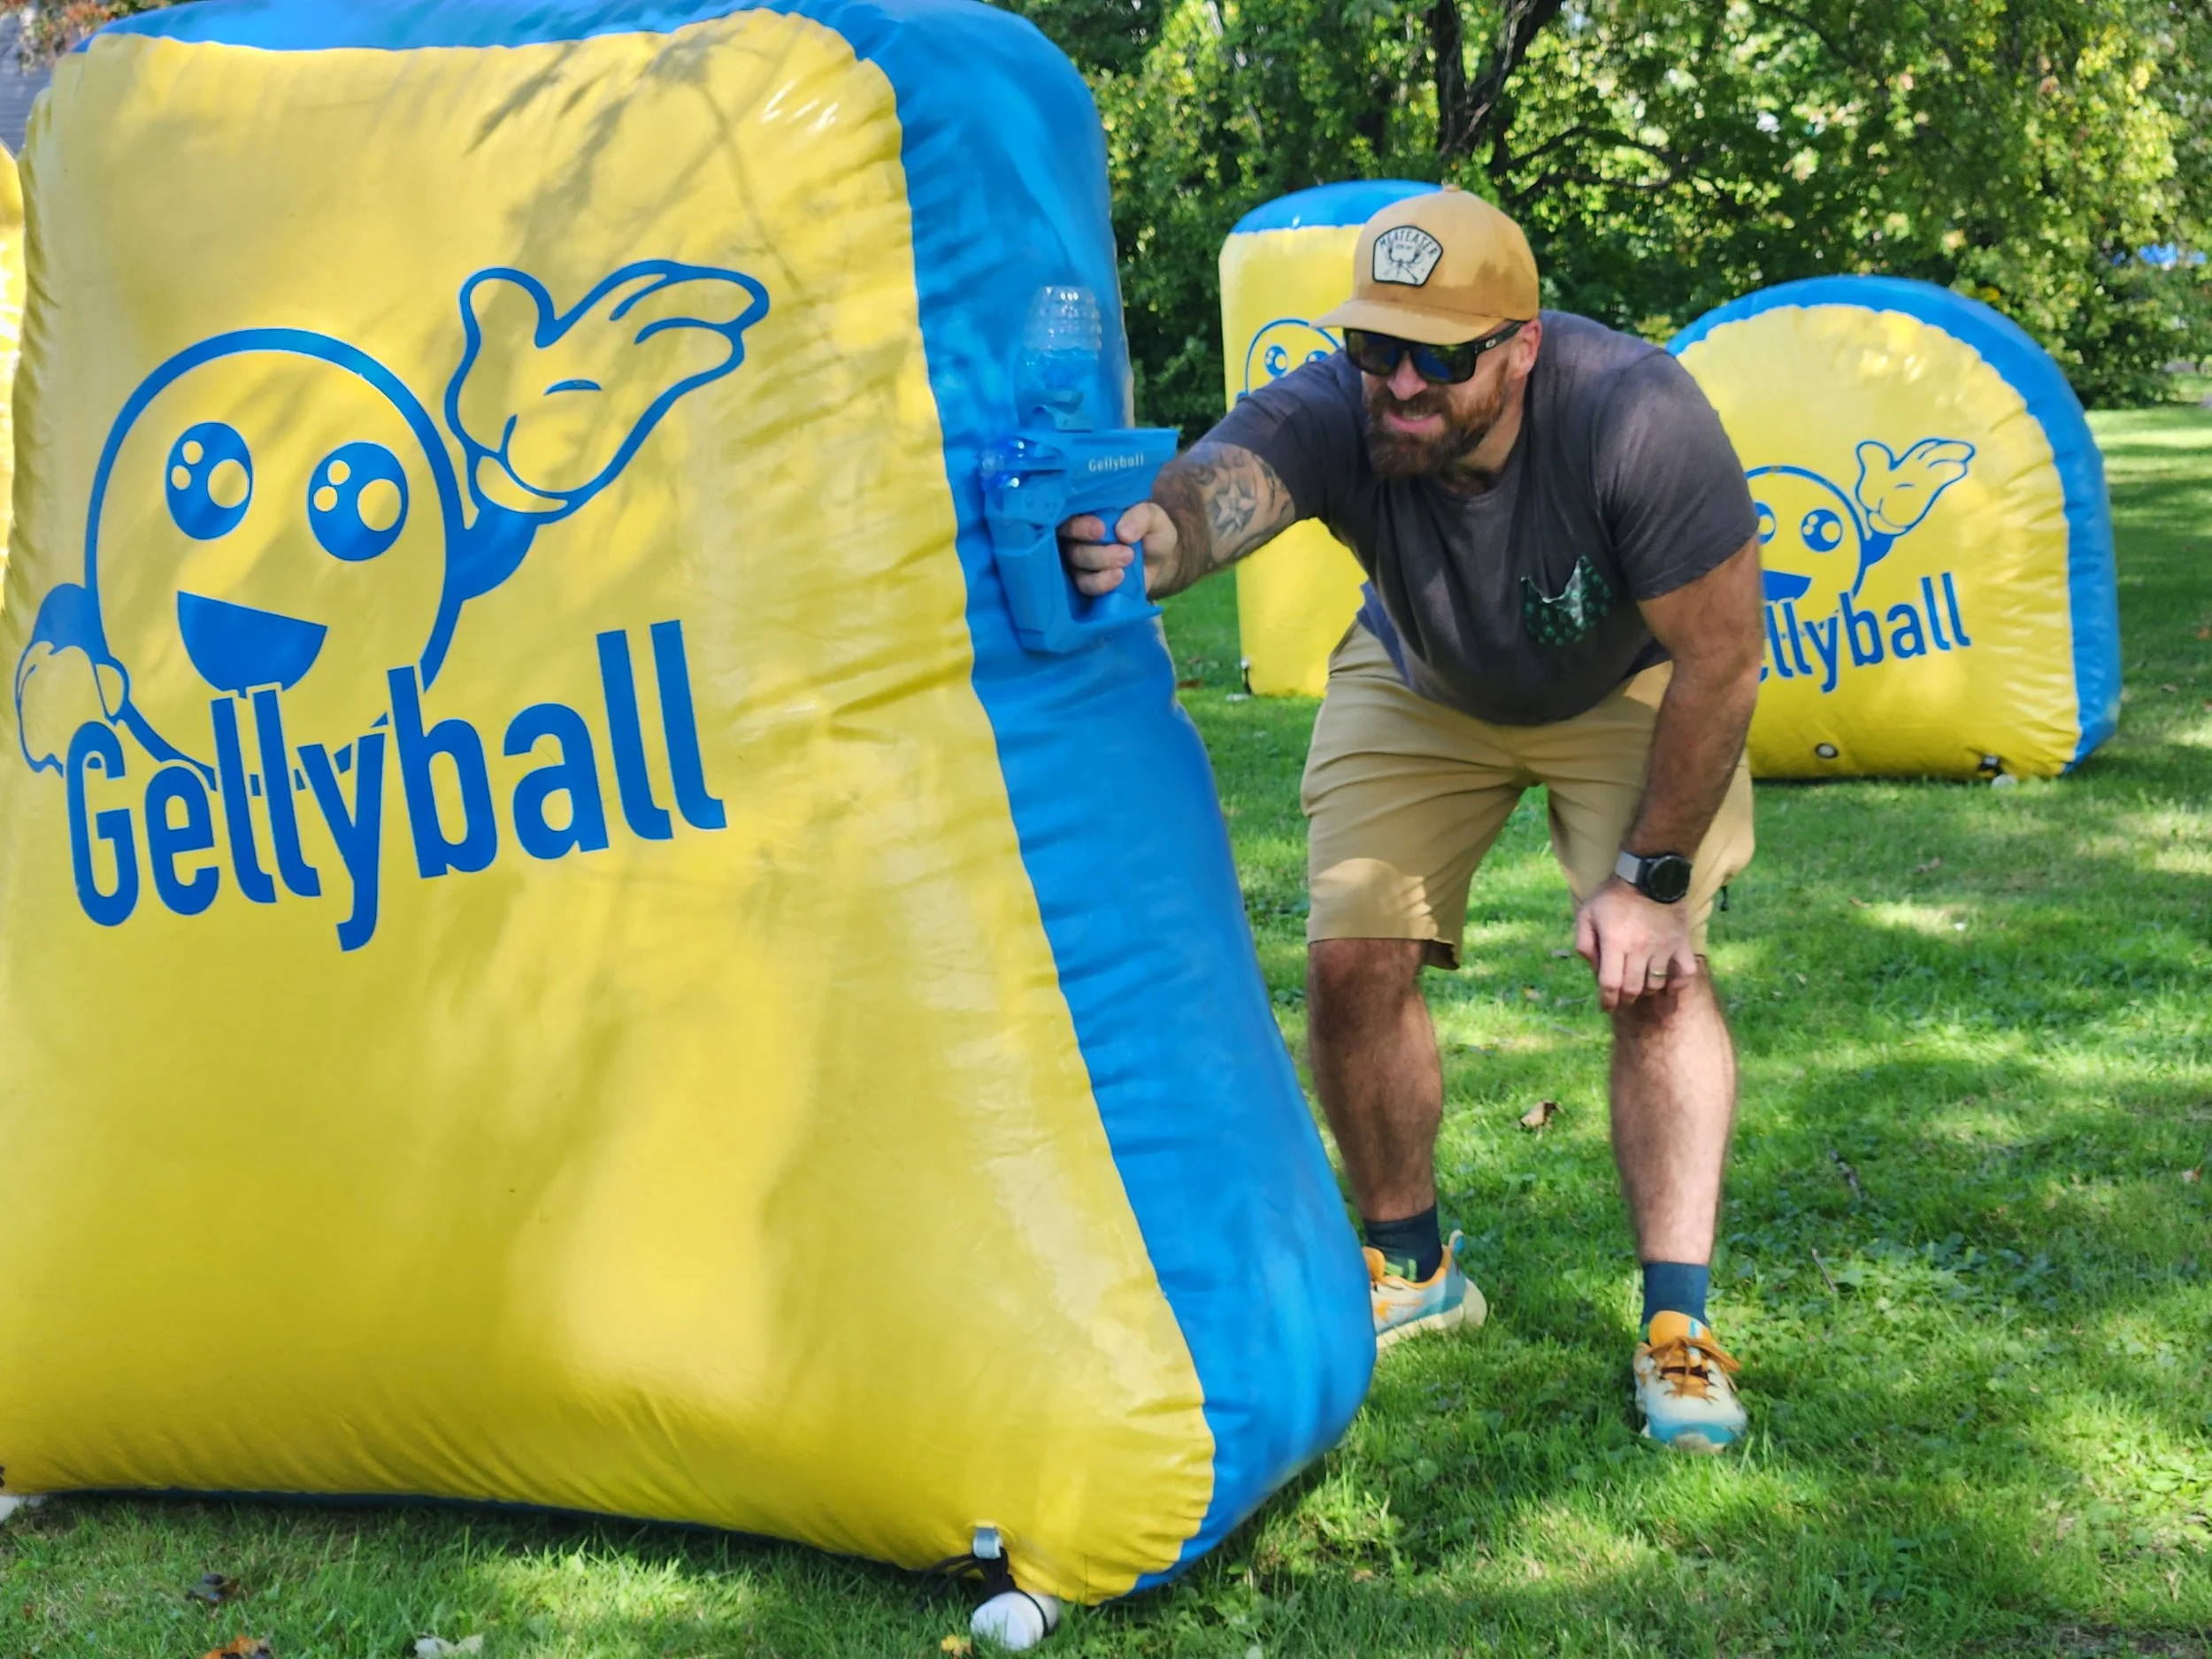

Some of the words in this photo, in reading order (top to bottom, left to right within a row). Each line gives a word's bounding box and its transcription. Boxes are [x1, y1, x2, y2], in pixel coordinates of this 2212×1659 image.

[1087, 451, 1145, 472] Gellyball
[1758, 572, 1970, 694] llyball
[66, 619, 727, 951] Gellyball
